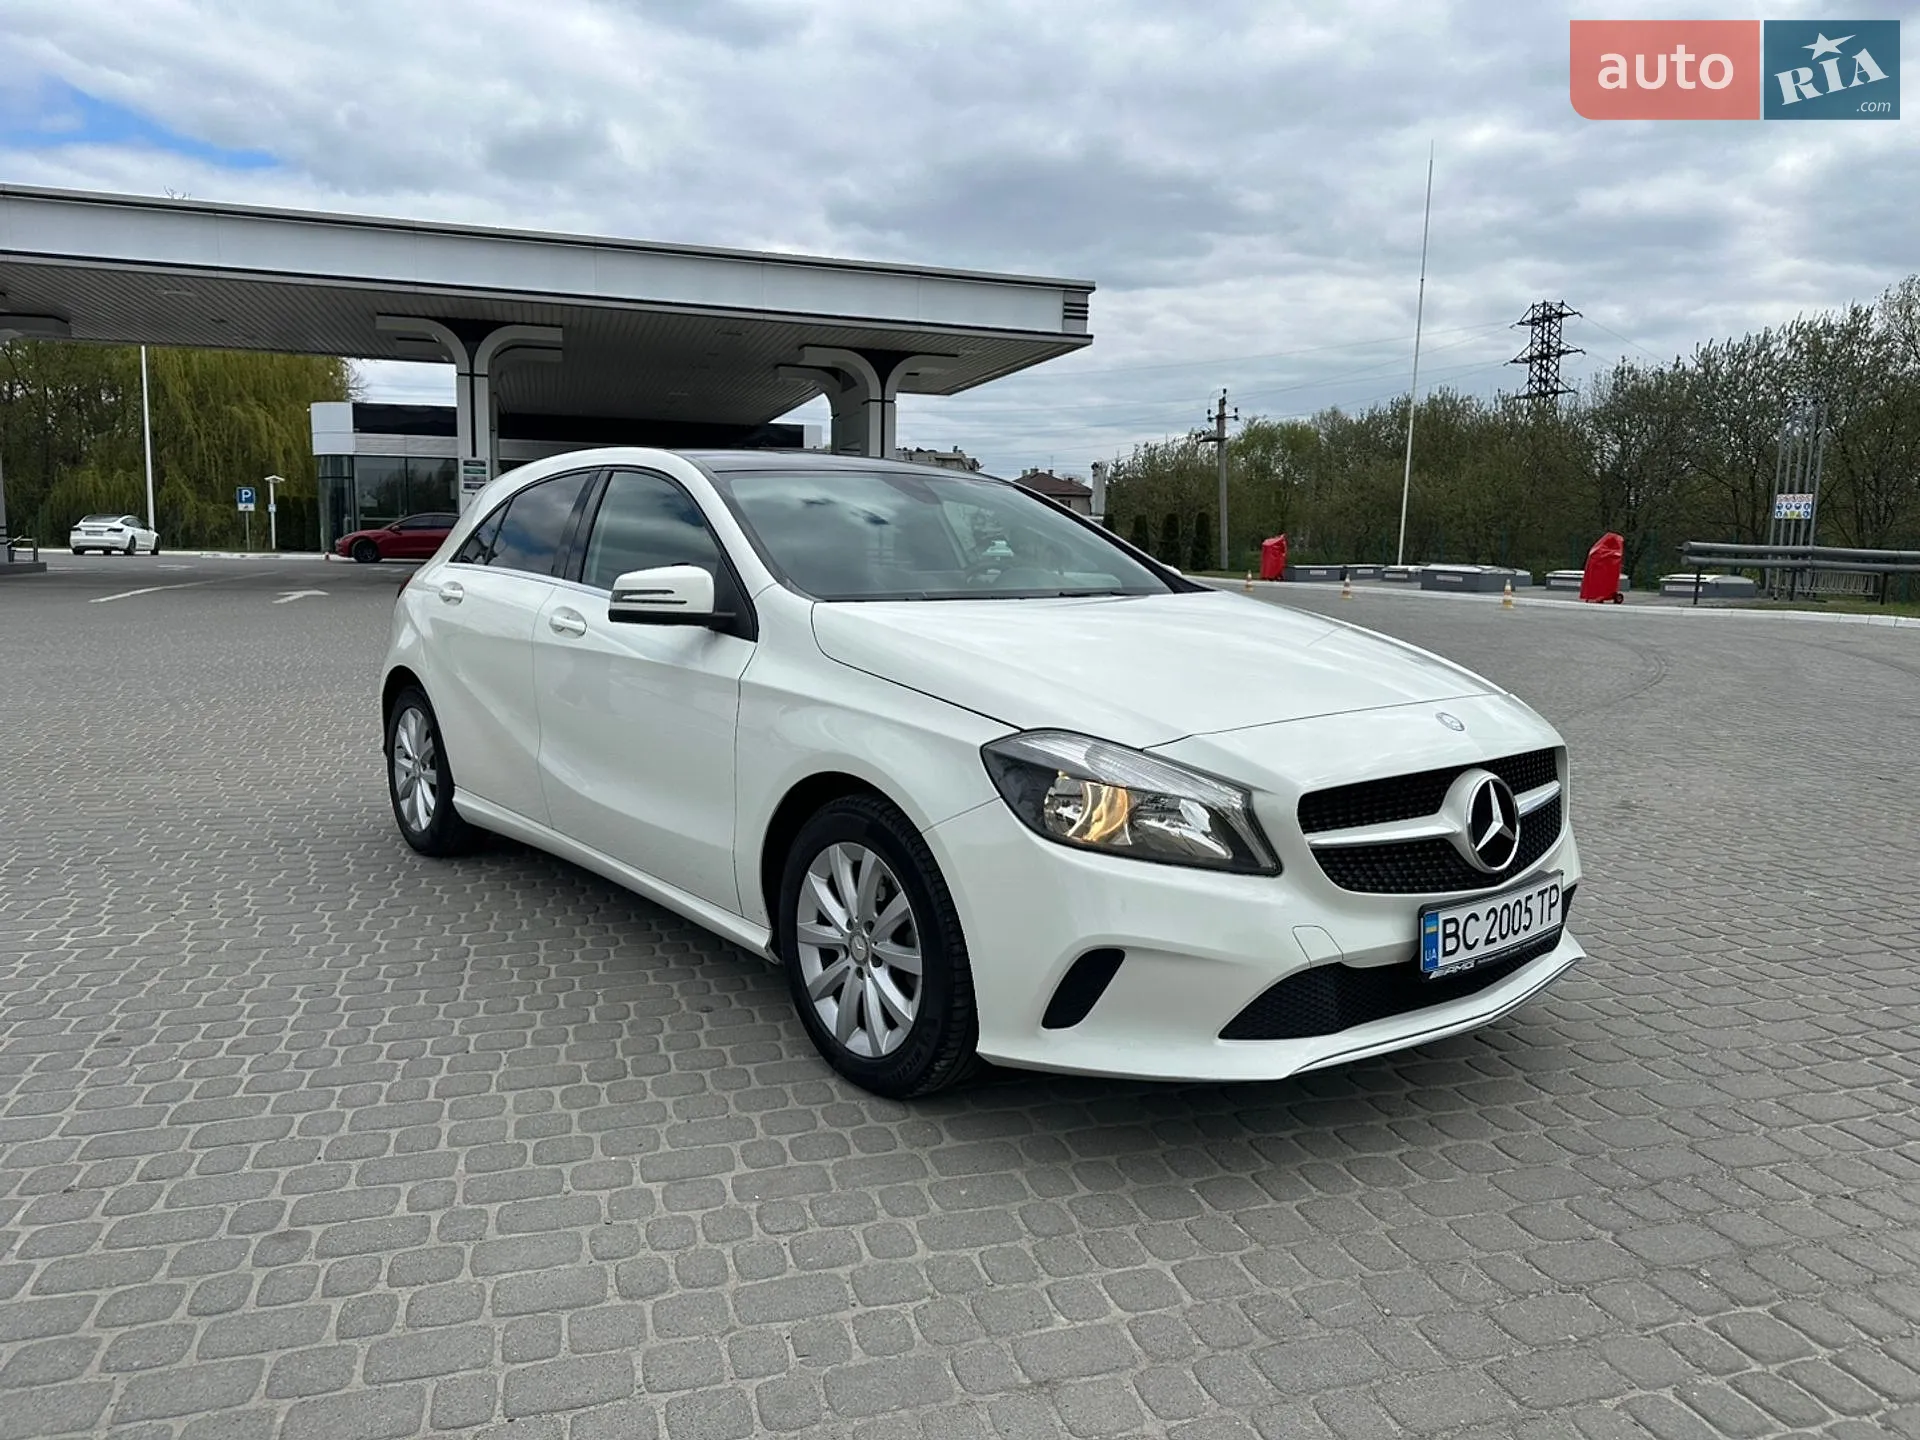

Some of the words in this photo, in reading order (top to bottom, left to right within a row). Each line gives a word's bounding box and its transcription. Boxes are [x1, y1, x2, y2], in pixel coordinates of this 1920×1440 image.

[241, 489, 252, 502] P
[1442, 912, 1480, 957] BC
[1484, 894, 1533, 946] 2005
[1537, 883, 1560, 925] TP
[1424, 947, 1438, 962] UA
